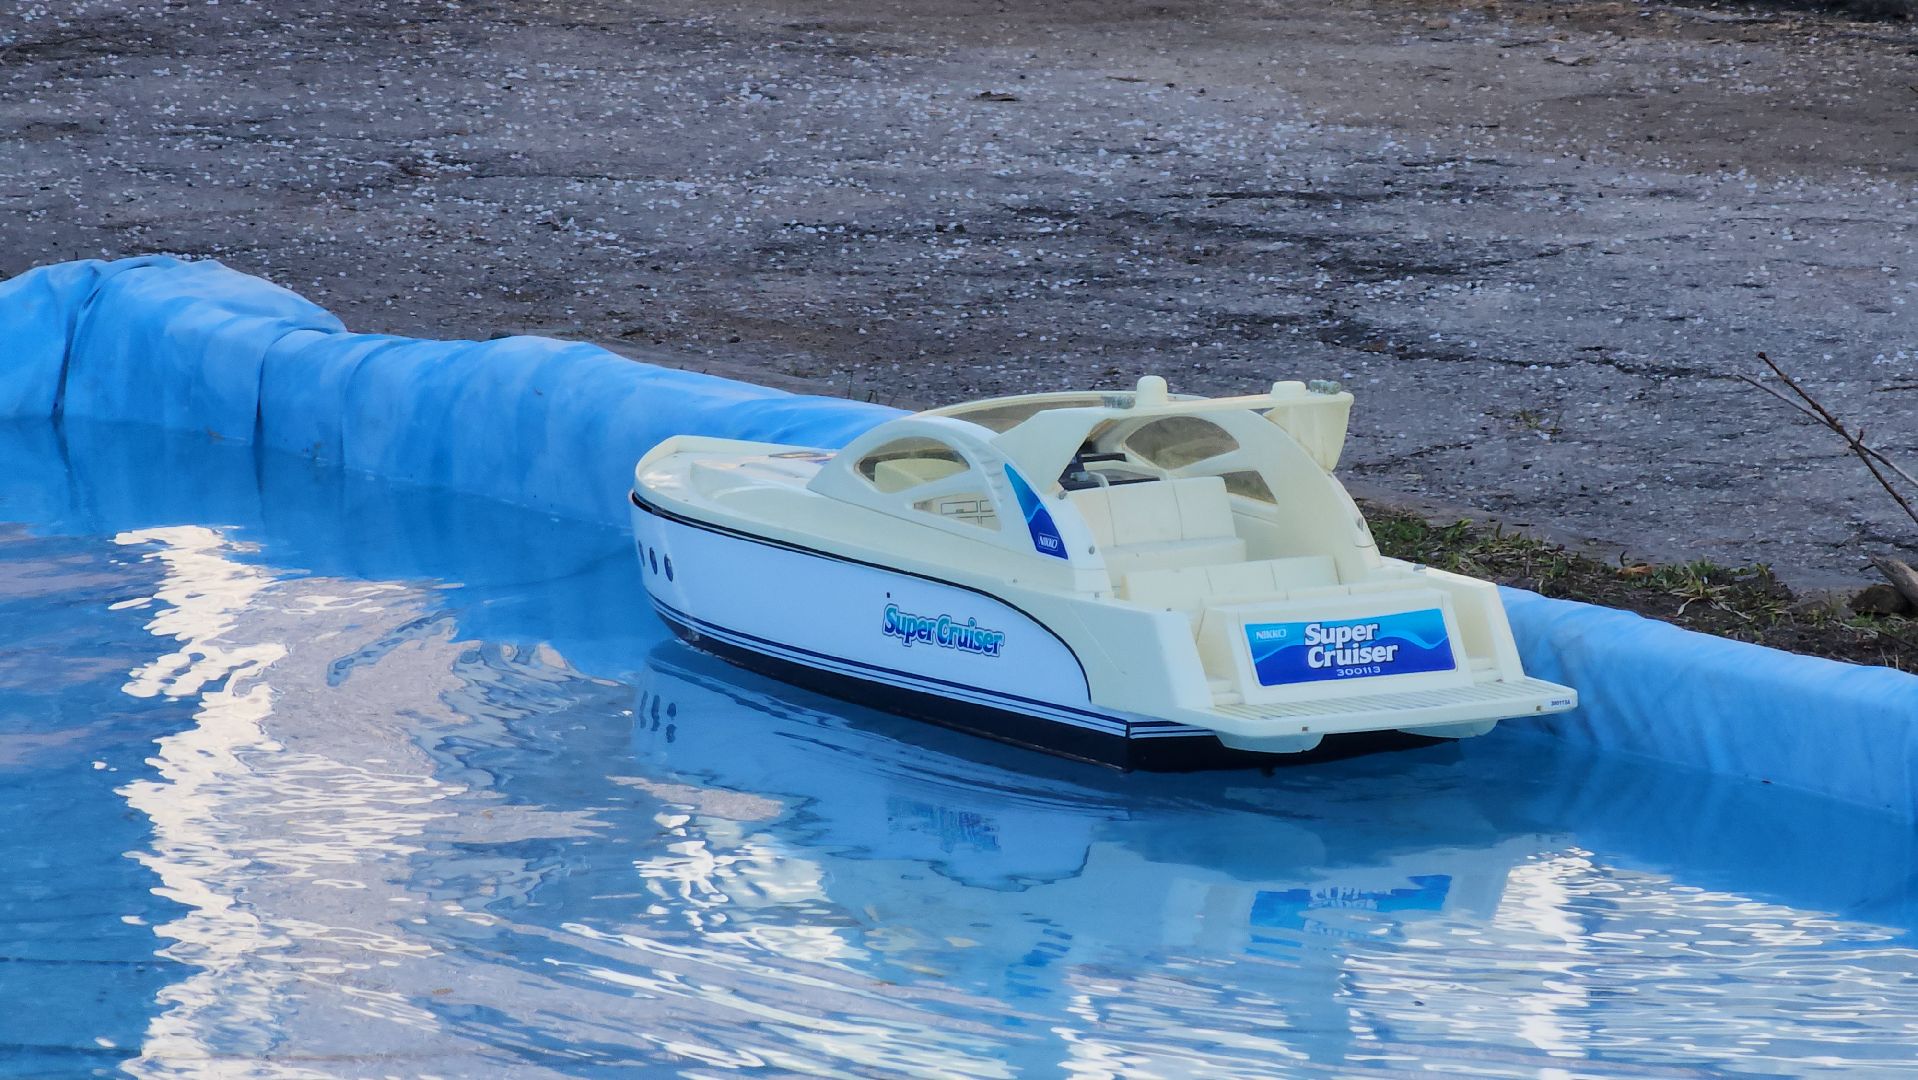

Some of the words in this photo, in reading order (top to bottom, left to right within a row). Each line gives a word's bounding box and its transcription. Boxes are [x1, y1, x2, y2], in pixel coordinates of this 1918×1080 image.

[1255, 629, 1287, 640] NIKKO
[1304, 623, 1379, 649] Super
[1307, 642, 1399, 669] Cruiser
[1336, 665, 1381, 677] 300113
